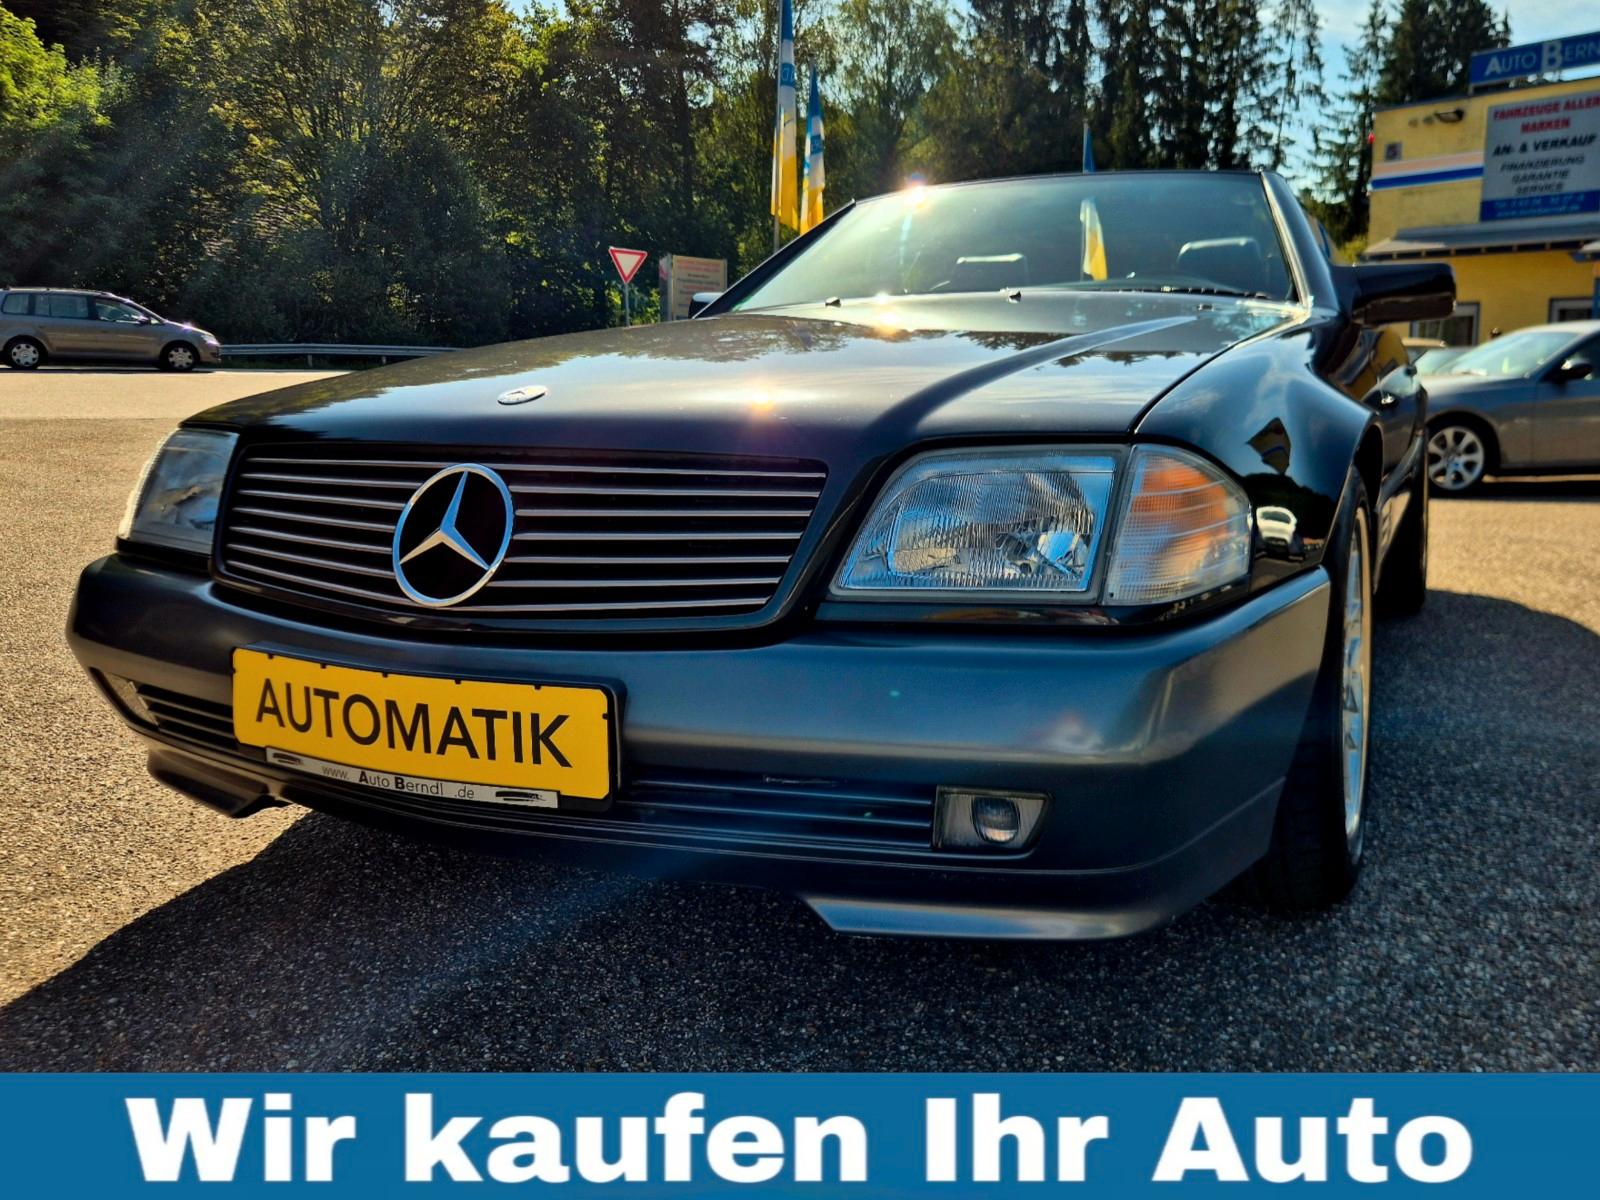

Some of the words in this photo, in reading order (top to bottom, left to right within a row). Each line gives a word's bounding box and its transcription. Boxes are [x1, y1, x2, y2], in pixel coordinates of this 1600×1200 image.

[1485, 52, 1536, 76] AUTO
[1521, 117, 1571, 133] MARKEN
[1533, 133, 1598, 151] VERKAUF
[1512, 170, 1570, 184] GARANTIE
[1516, 182, 1564, 194] SERVICE
[256, 678, 574, 768] AUTOMATIK
[321, 765, 350, 780] www.
[358, 770, 390, 788] Auto
[394, 776, 444, 796] Berndl
[454, 785, 475, 799] .de
